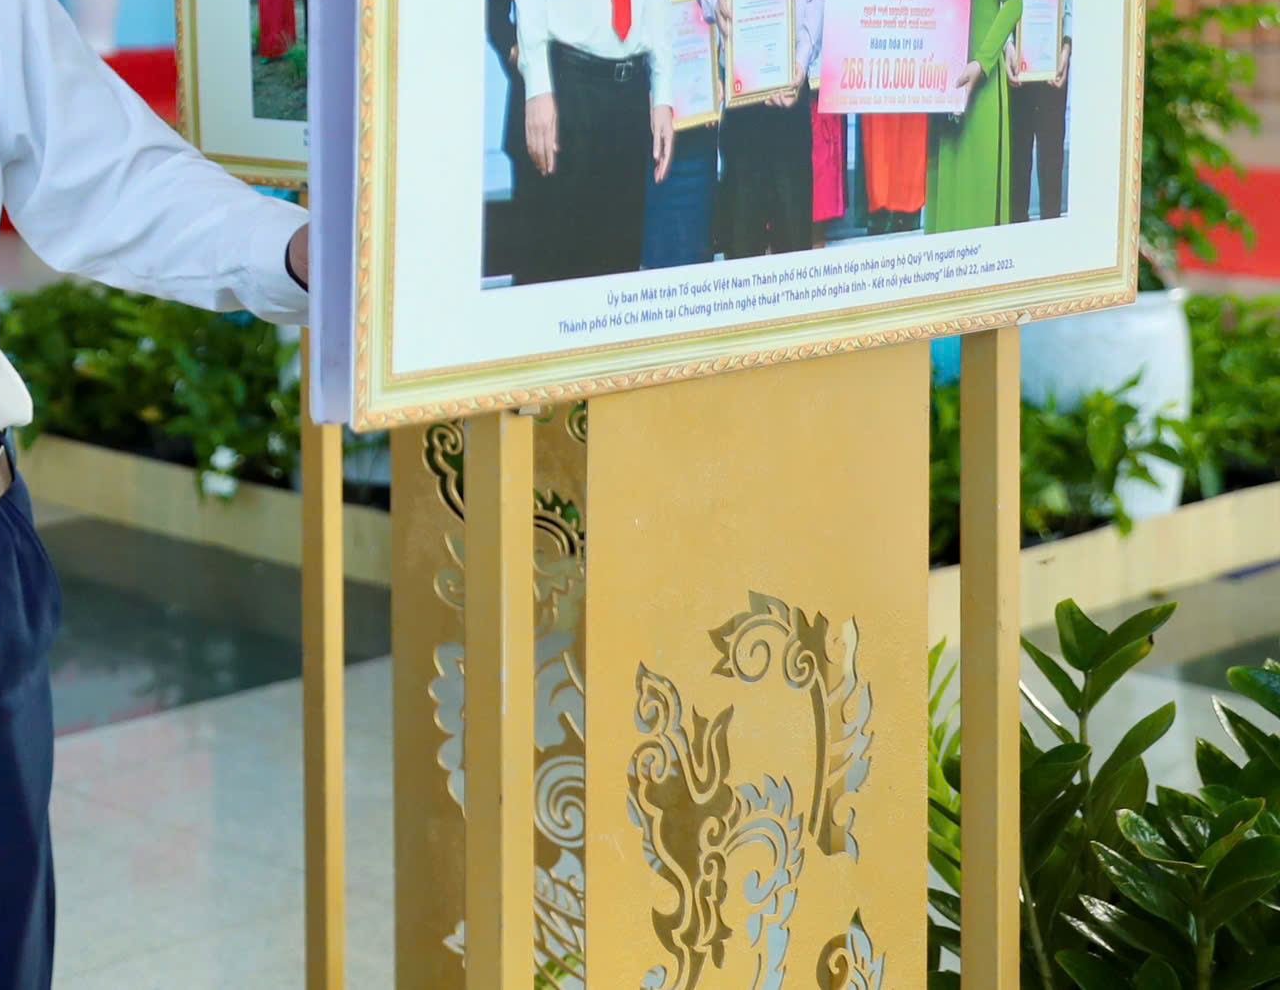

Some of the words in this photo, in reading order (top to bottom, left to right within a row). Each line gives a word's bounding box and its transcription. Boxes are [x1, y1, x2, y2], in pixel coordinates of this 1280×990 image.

[621, 292, 638, 304] ban
[640, 288, 657, 303] Mặt
[731, 277, 750, 289] Nam
[752, 274, 777, 286] Thành
[823, 264, 842, 277] Minh
[558, 319, 587, 334] Thành
[640, 309, 663, 322] Minh
[679, 303, 711, 317] Chương
